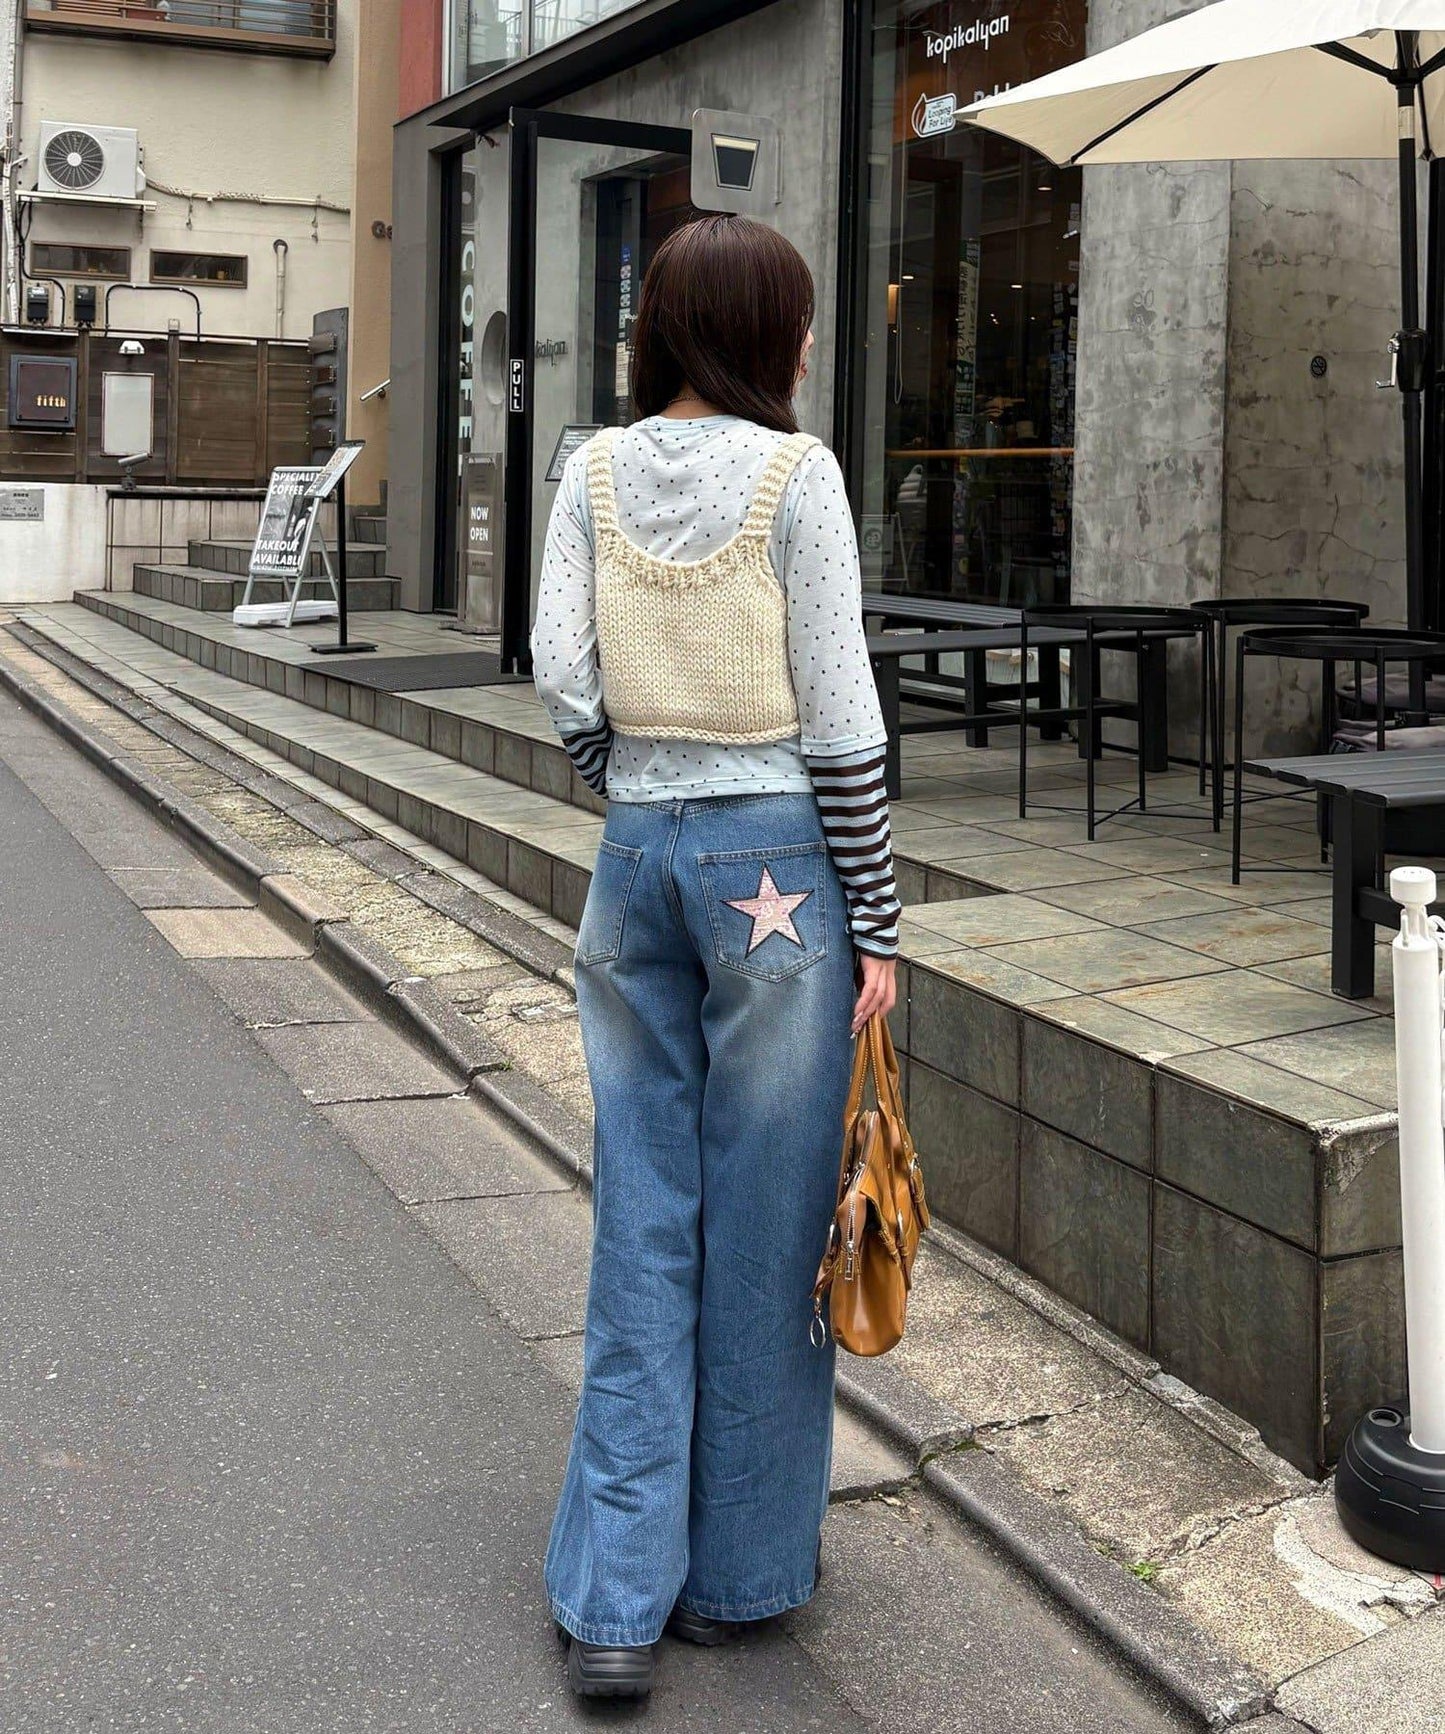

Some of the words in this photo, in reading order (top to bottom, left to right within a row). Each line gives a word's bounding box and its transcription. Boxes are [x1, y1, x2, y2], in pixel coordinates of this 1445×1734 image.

[926, 15, 1009, 63] kopikalyan
[512, 362, 521, 409] PULL
[37, 395, 66, 407] fifth
[271, 485, 305, 495] COFFEE
[470, 506, 489, 520] NOW
[469, 527, 489, 541] OPEN
[256, 540, 300, 552] TAKEOUT
